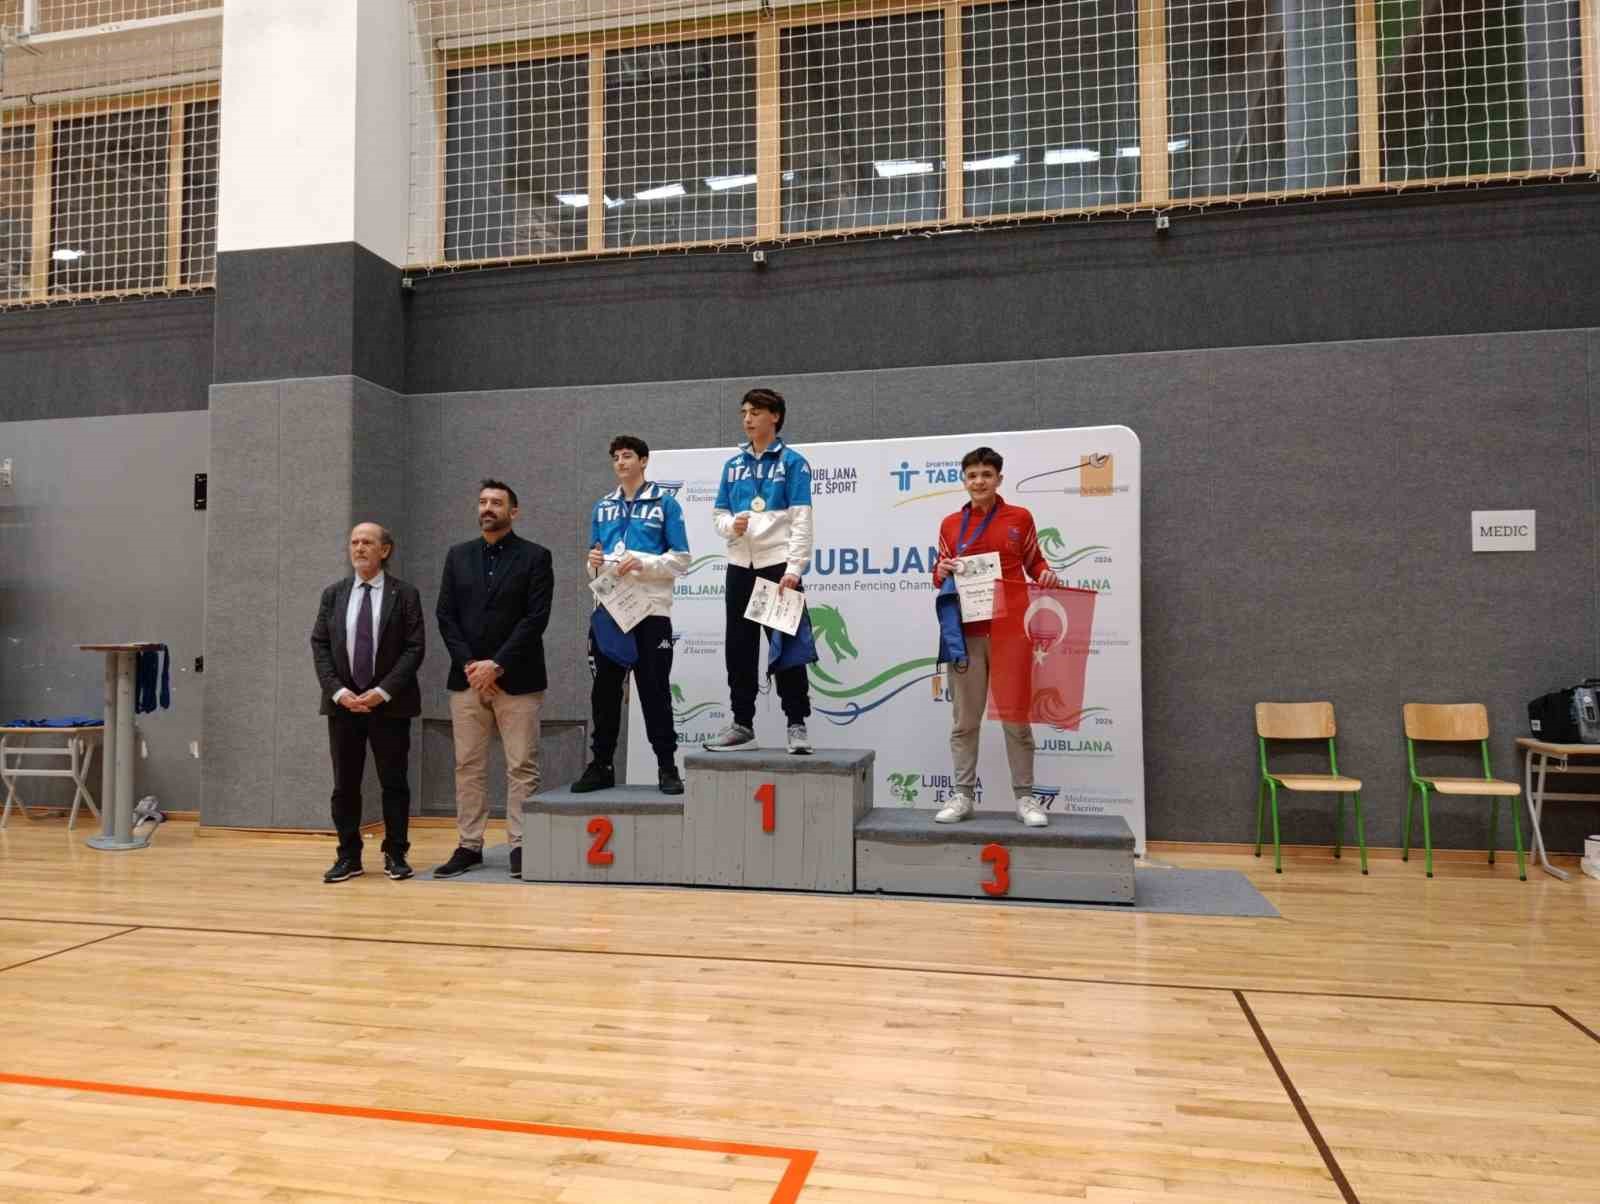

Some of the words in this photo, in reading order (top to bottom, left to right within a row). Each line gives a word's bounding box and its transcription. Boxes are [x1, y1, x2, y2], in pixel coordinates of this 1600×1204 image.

[728, 460, 786, 483] ITALIA
[812, 467, 857, 481] UBLJANA
[925, 468, 966, 484] TAB
[812, 483, 822, 495] JE
[825, 480, 857, 494] ŠPORT
[597, 504, 665, 523] ITALIA
[1479, 524, 1529, 538] MEDIC
[673, 584, 726, 595] UBLJANA
[803, 582, 850, 592] erranean
[854, 580, 897, 593] Fencing
[1034, 738, 1113, 752] JUBLJANA
[922, 775, 983, 789] LJUBLA
[934, 790, 945, 803] JE
[754, 784, 776, 833] 1
[586, 816, 614, 866] 2
[980, 842, 1011, 898] 3
